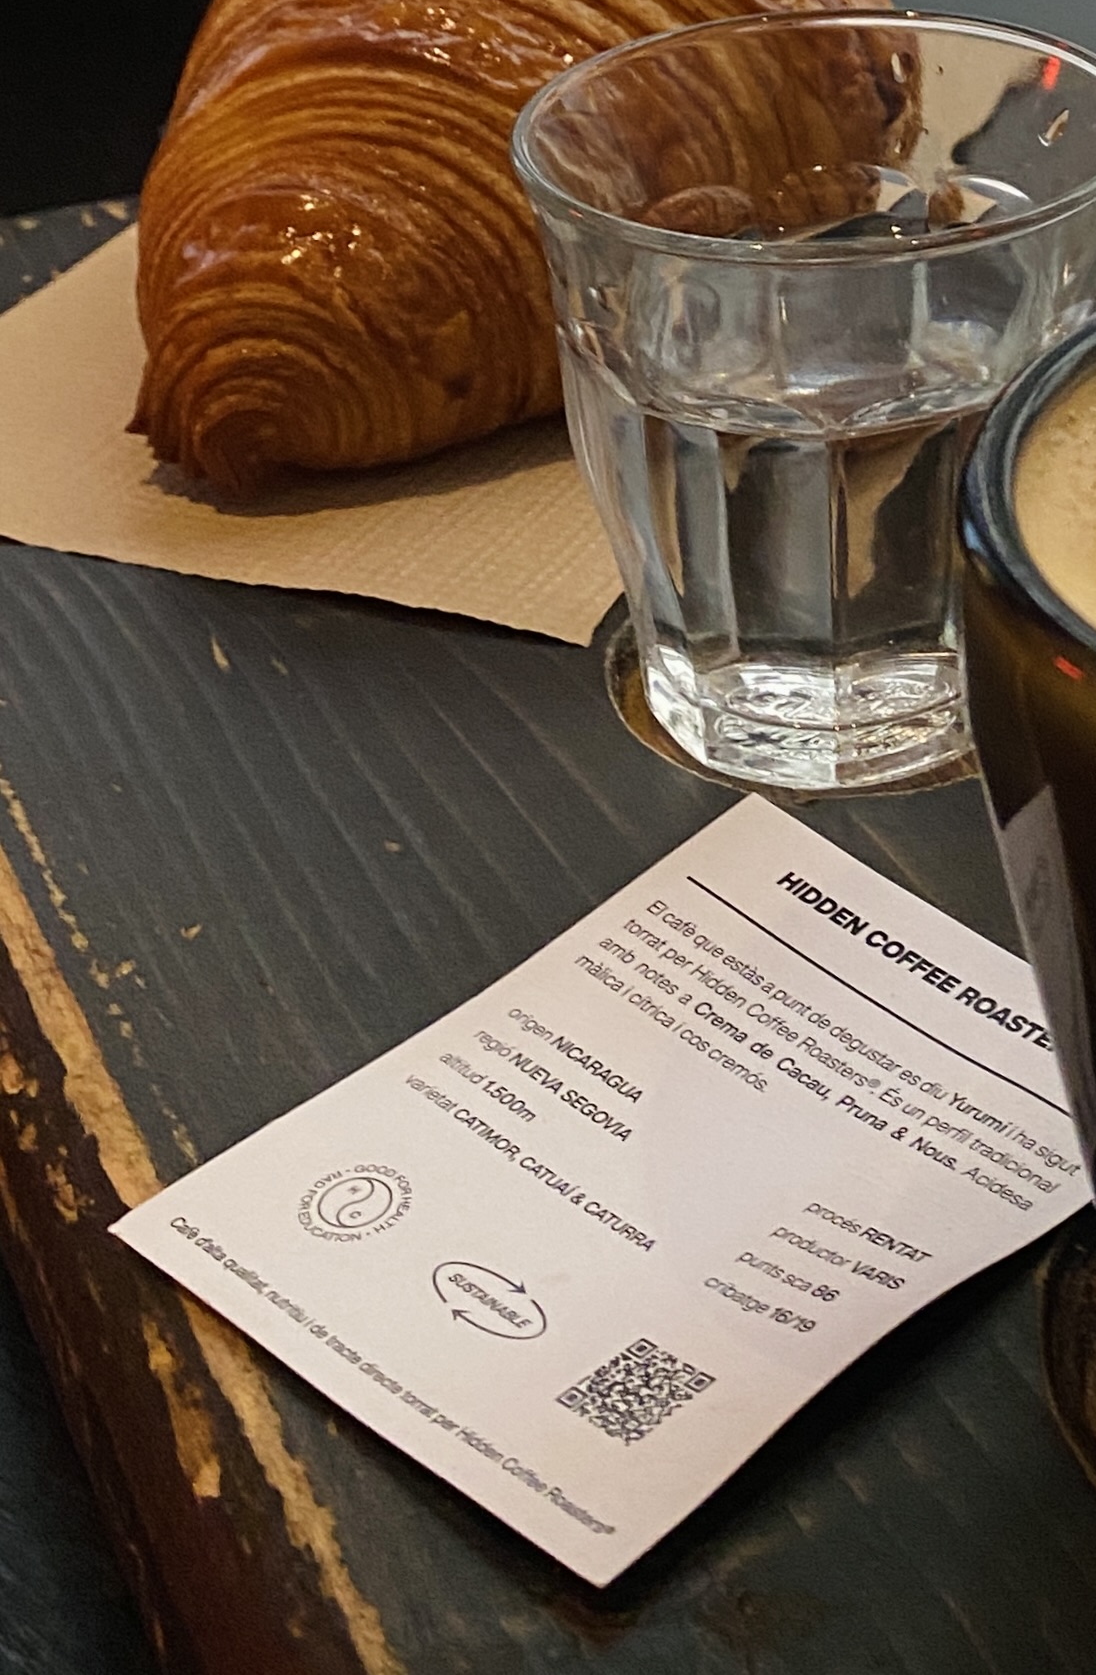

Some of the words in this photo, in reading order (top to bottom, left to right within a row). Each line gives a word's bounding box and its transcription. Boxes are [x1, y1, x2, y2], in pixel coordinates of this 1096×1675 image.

[645, 900, 670, 917] El
[661, 913, 698, 938] cafè
[693, 935, 725, 958] que
[776, 871, 871, 936] HIDDEN
[865, 930, 963, 994] COFFEE
[953, 986, 1057, 1052] ROASTE
[722, 955, 765, 986] estàs
[760, 982, 776, 994] a
[574, 954, 625, 992] màlica
[680, 1029, 713, 1052] cos
[708, 1049, 768, 1093] cremós.
[767, 989, 812, 1017] punt
[807, 1012, 831, 1029] de
[508, 1009, 554, 1041] origen
[550, 1037, 642, 1103] NICARAGUA
[622, 919, 669, 953] torrat
[657, 948, 694, 969] per
[688, 964, 747, 1008] Hidden
[746, 1003, 804, 1043] Coffee
[876, 1087, 905, 1108] És
[900, 1103, 926, 1120] un
[920, 1115, 974, 1144] perfil
[968, 1138, 1062, 1193] tradicional
[828, 1026, 903, 1072] degustar
[439, 1054, 489, 1084] altitud
[481, 1081, 536, 1122] 1.500m
[473, 1031, 517, 1057] regió
[508, 1052, 565, 1095] NUEVA
[560, 1089, 632, 1142] SEGOVIA
[597, 938, 637, 964] amb
[633, 963, 679, 995] notes
[677, 993, 693, 1006] a
[694, 1002, 749, 1044] Crema
[747, 1042, 776, 1060] de
[776, 1057, 832, 1101] Cacau,
[835, 1094, 888, 1131] Pruna
[890, 1127, 909, 1142] &
[908, 1136, 958, 1171] Nous.
[960, 1167, 1034, 1211] Acidesa
[895, 1070, 922, 1086] es
[918, 1082, 950, 1100] diu
[1012, 1130, 1036, 1151] ha
[354, 1163, 398, 1178] GOOD
[406, 1075, 459, 1112] varietat
[453, 1108, 521, 1162] CATIMOR,
[570, 1193, 586, 1205] &
[583, 1201, 656, 1252] CATURRA
[1033, 1146, 1083, 1177] sigut
[395, 1174, 412, 1196] FOR
[373, 1197, 412, 1233] HEALTH
[804, 1203, 861, 1232] procés
[862, 1228, 932, 1262] RENTAT
[735, 1252, 785, 1279] punts
[783, 1274, 813, 1292] sca
[810, 1284, 840, 1302] 86
[770, 1227, 852, 1266] productor
[850, 1260, 906, 1290] VARIS
[448, 1273, 533, 1329] SUSTAINABLE
[704, 1278, 771, 1314] cribatge
[770, 1307, 817, 1332] 16/19
